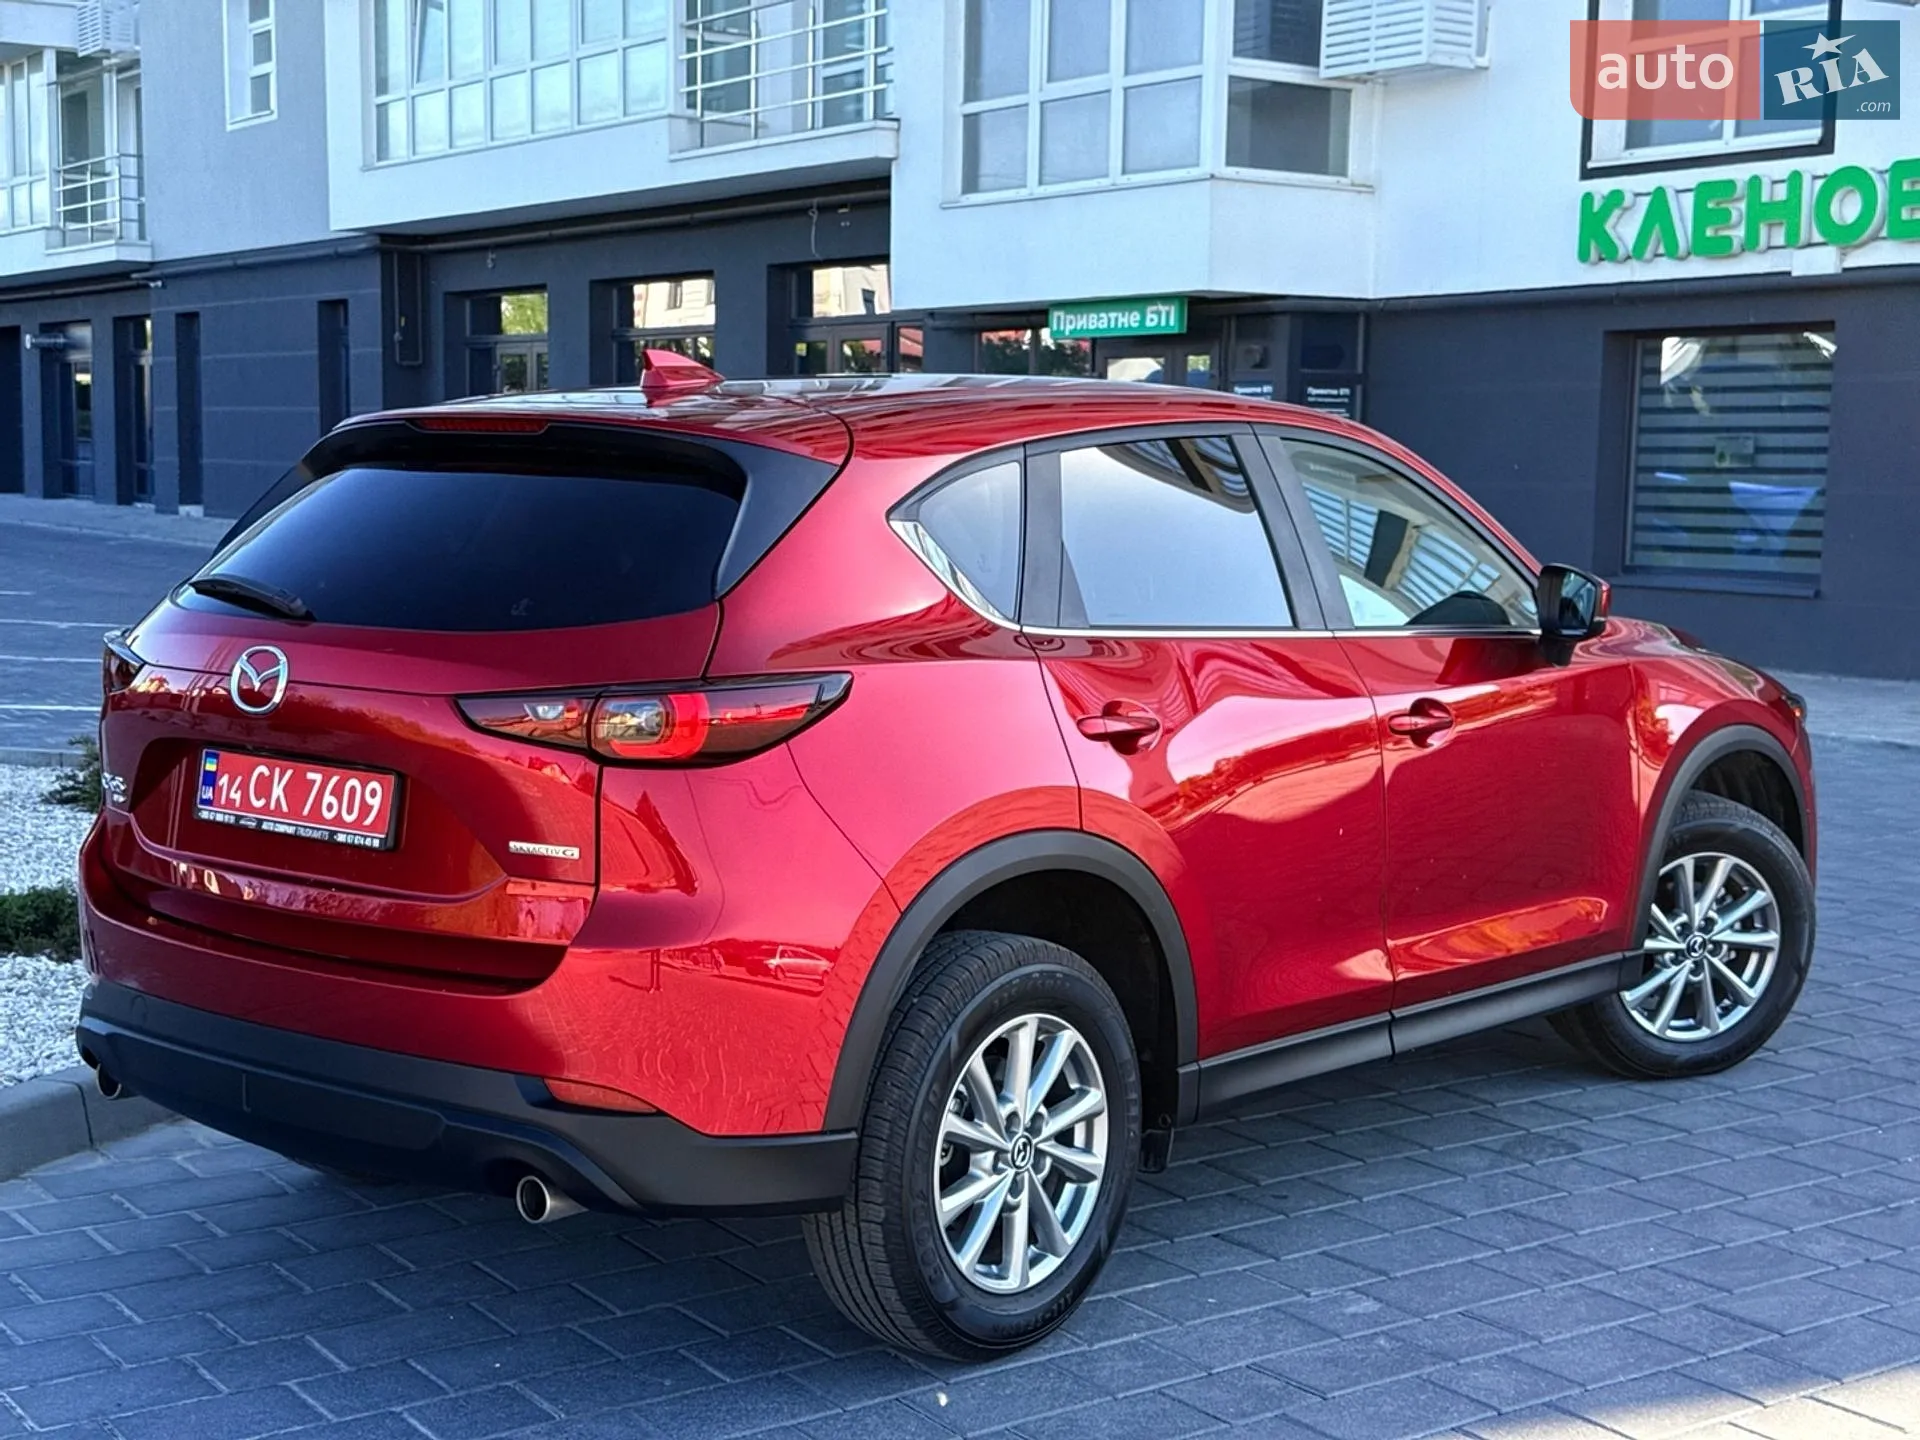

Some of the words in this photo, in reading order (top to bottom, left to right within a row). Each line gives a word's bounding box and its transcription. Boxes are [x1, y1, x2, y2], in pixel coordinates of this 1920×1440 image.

[1052, 310, 1141, 336] Приватне
[202, 785, 214, 800] UA
[218, 773, 244, 808] 14
[249, 764, 294, 813] CK
[302, 771, 383, 826] 7609
